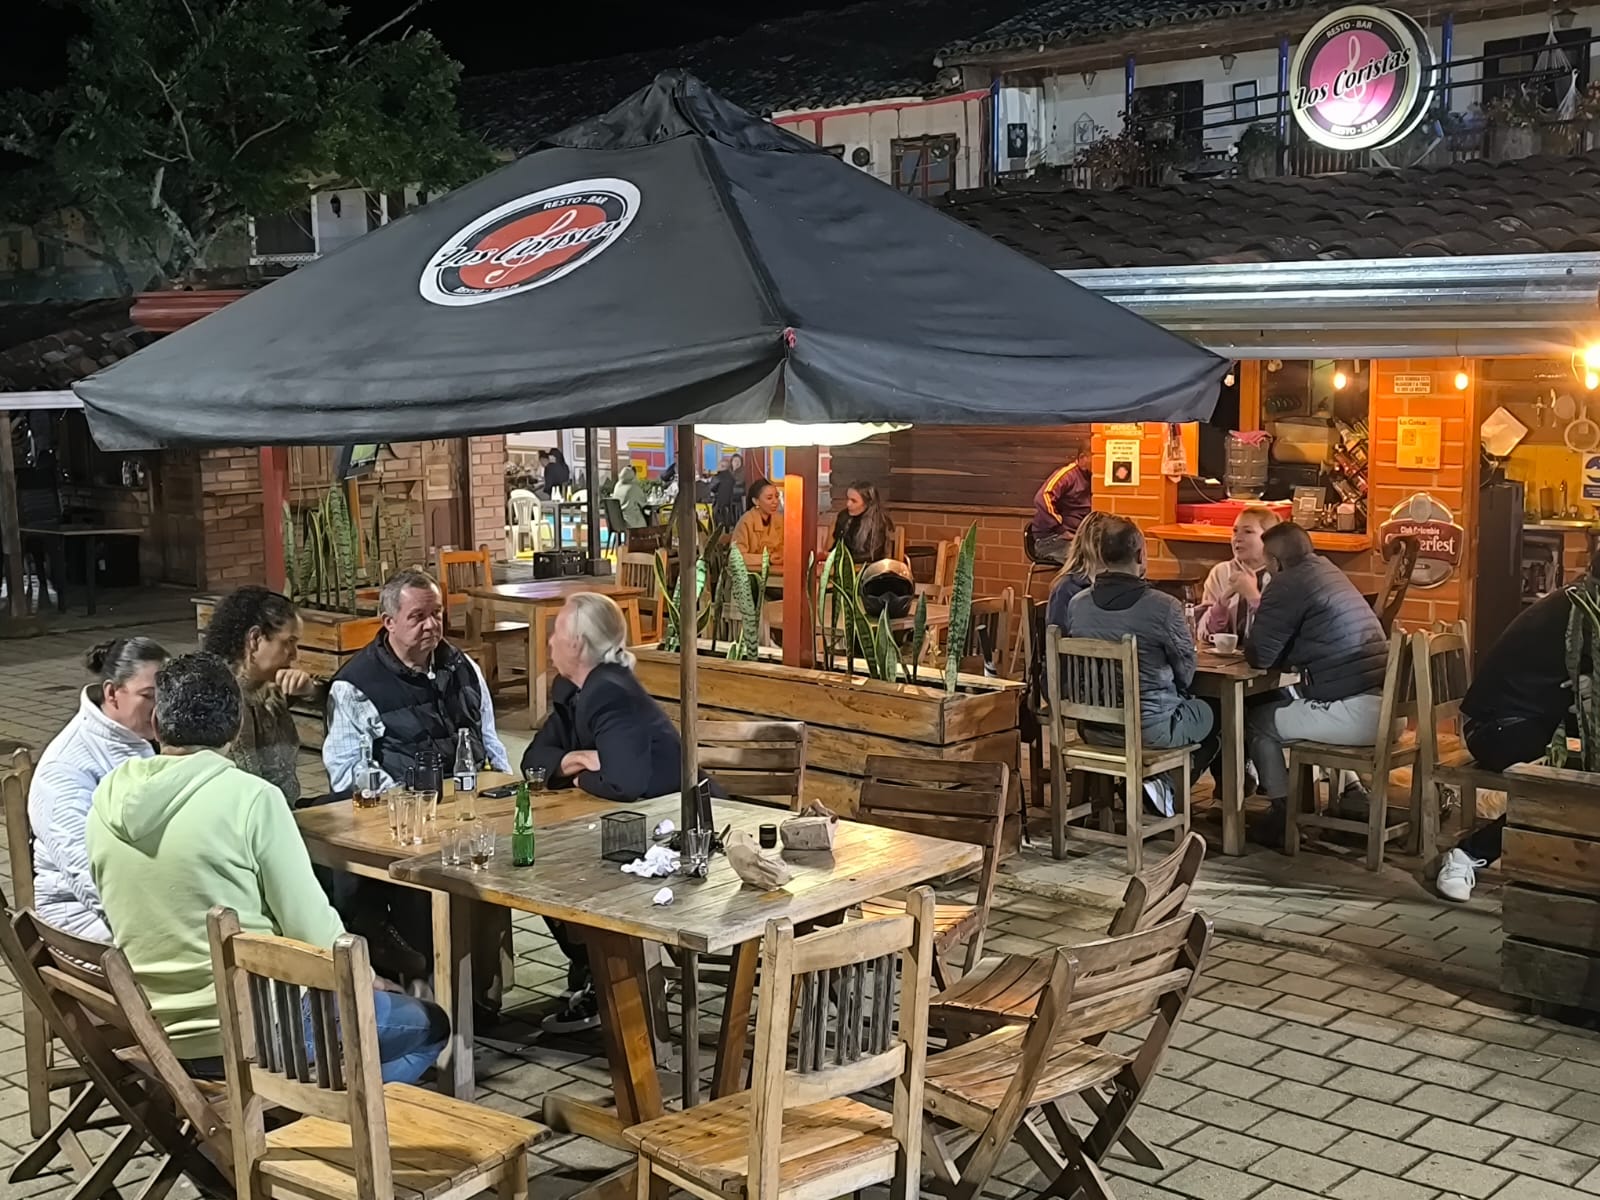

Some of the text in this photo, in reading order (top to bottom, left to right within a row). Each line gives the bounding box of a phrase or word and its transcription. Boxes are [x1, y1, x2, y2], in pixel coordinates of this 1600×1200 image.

[1326, 20, 1373, 38] RESTO BAR
[1294, 47, 1411, 110] Los Coristas
[543, 195, 608, 210] RESTO BAR
[433, 246, 493, 269] Los
